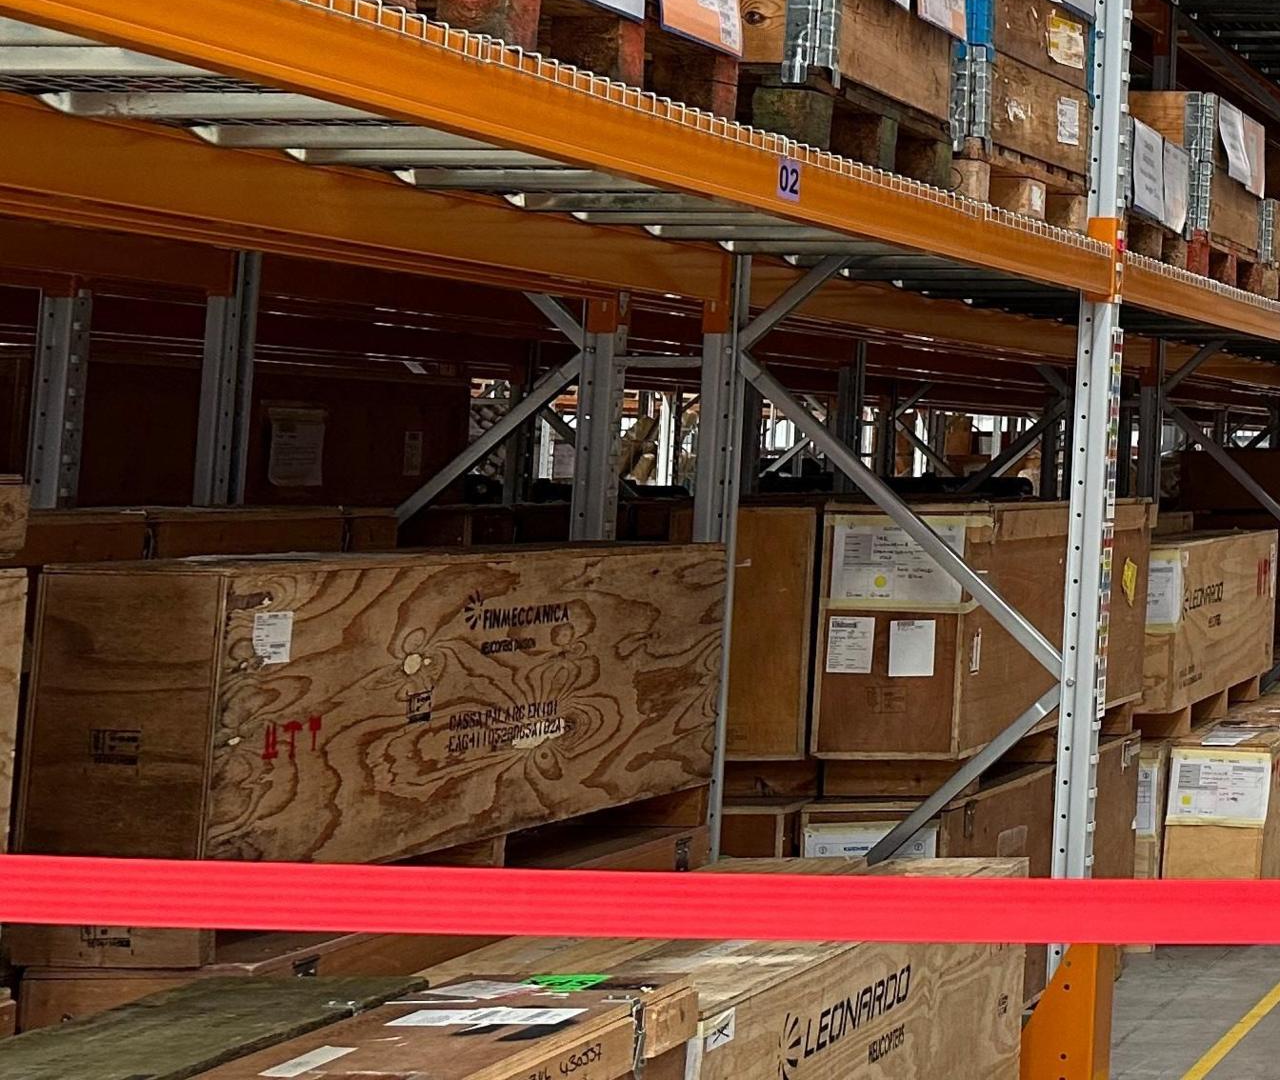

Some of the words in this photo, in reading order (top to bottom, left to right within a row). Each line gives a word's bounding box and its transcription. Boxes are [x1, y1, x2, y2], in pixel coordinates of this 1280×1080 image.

[780, 164, 799, 195] 02
[482, 603, 570, 630] FINMECCANICA
[804, 963, 911, 1059] LEONARDO
[868, 1023, 905, 1065] HELICOPTERS
